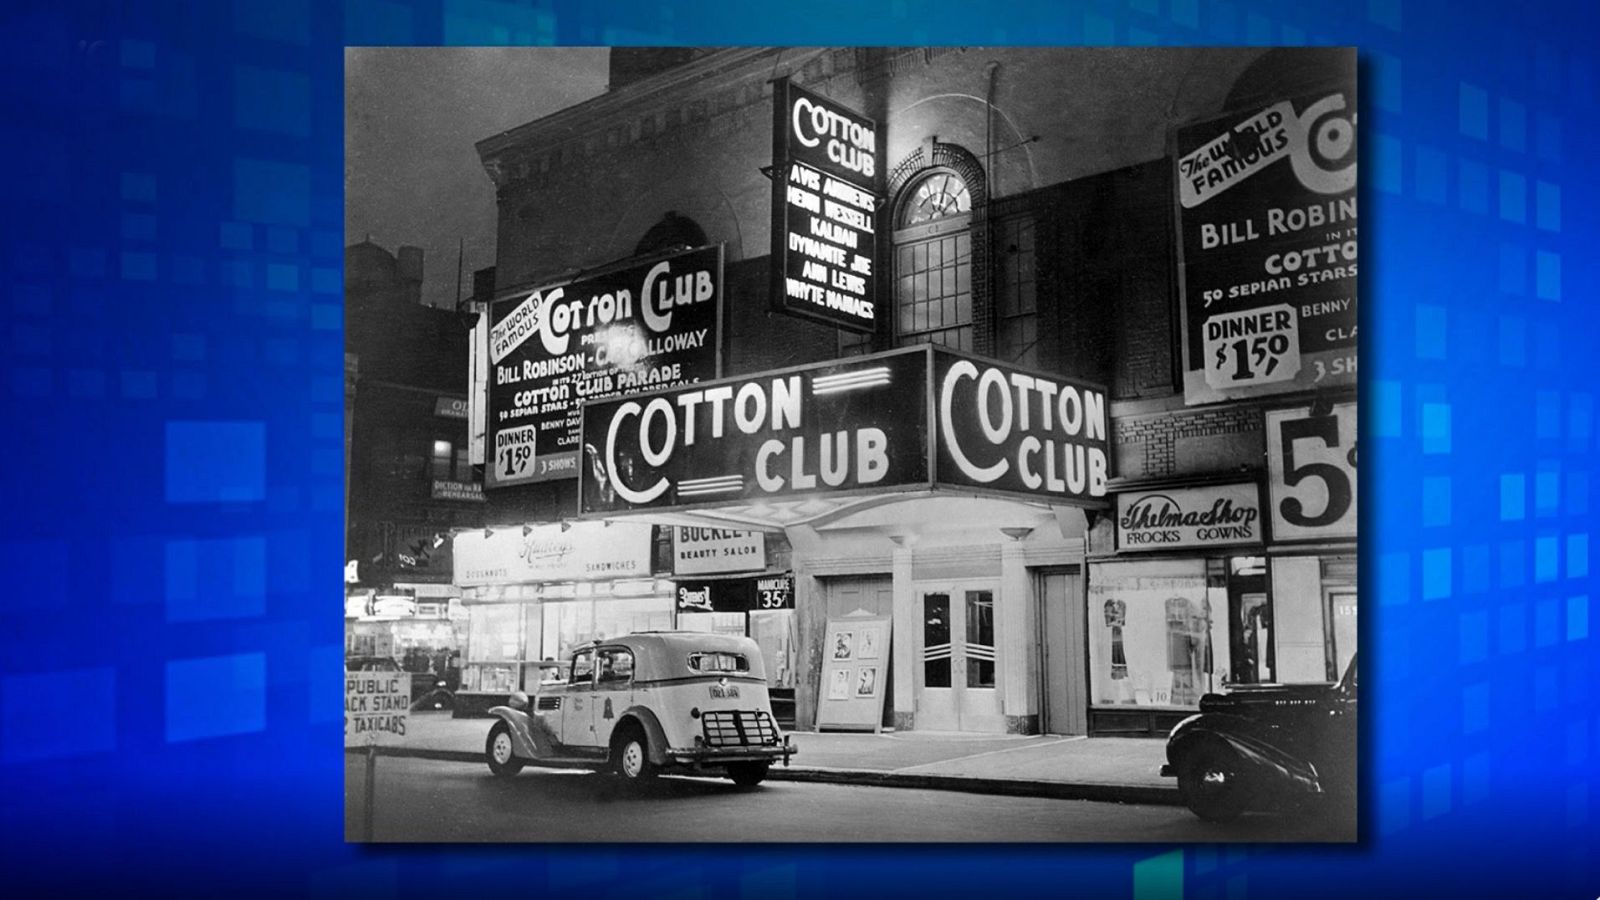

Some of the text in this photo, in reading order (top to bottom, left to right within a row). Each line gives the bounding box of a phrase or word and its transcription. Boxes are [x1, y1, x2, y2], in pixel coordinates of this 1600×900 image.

[793, 97, 875, 153] COTTON
[1209, 111, 1283, 163] WLD
[828, 139, 875, 177] CLUB
[1201, 197, 1357, 249] BILL ROBIN
[1326, 231, 1341, 242] IN
[789, 232, 847, 268] DYNAMITE
[1265, 240, 1357, 275] COTTO
[641, 260, 714, 332] CLUB
[1203, 264, 1357, 308] 50 SEPIAN STARS
[506, 297, 540, 332] WORLD
[1208, 310, 1292, 341] DINNER
[1302, 298, 1350, 318] BENNY
[495, 312, 540, 356] FAMOUS
[497, 366, 521, 385] BILL
[523, 352, 585, 380] ROBINSON
[648, 329, 708, 356] LLOWAY
[1313, 361, 1326, 382] 3
[576, 377, 613, 397] CLUB
[617, 363, 681, 390] PARADE
[541, 401, 568, 413] STARS
[941, 360, 1105, 482] COTTON
[498, 429, 533, 448] DINNER
[606, 376, 801, 504] COTTON
[548, 457, 576, 471] SHOWS
[756, 427, 889, 492] CLUB
[1018, 436, 1107, 497] CLUB
[681, 546, 757, 560] BEAUTY SALON
[1126, 526, 1253, 545] FROCKS GOWNS
[586, 561, 636, 573] SANDWICHES
[347, 680, 399, 694] PUBLIC
[373, 695, 408, 711] STAND
[353, 715, 406, 737] TAXICABS
